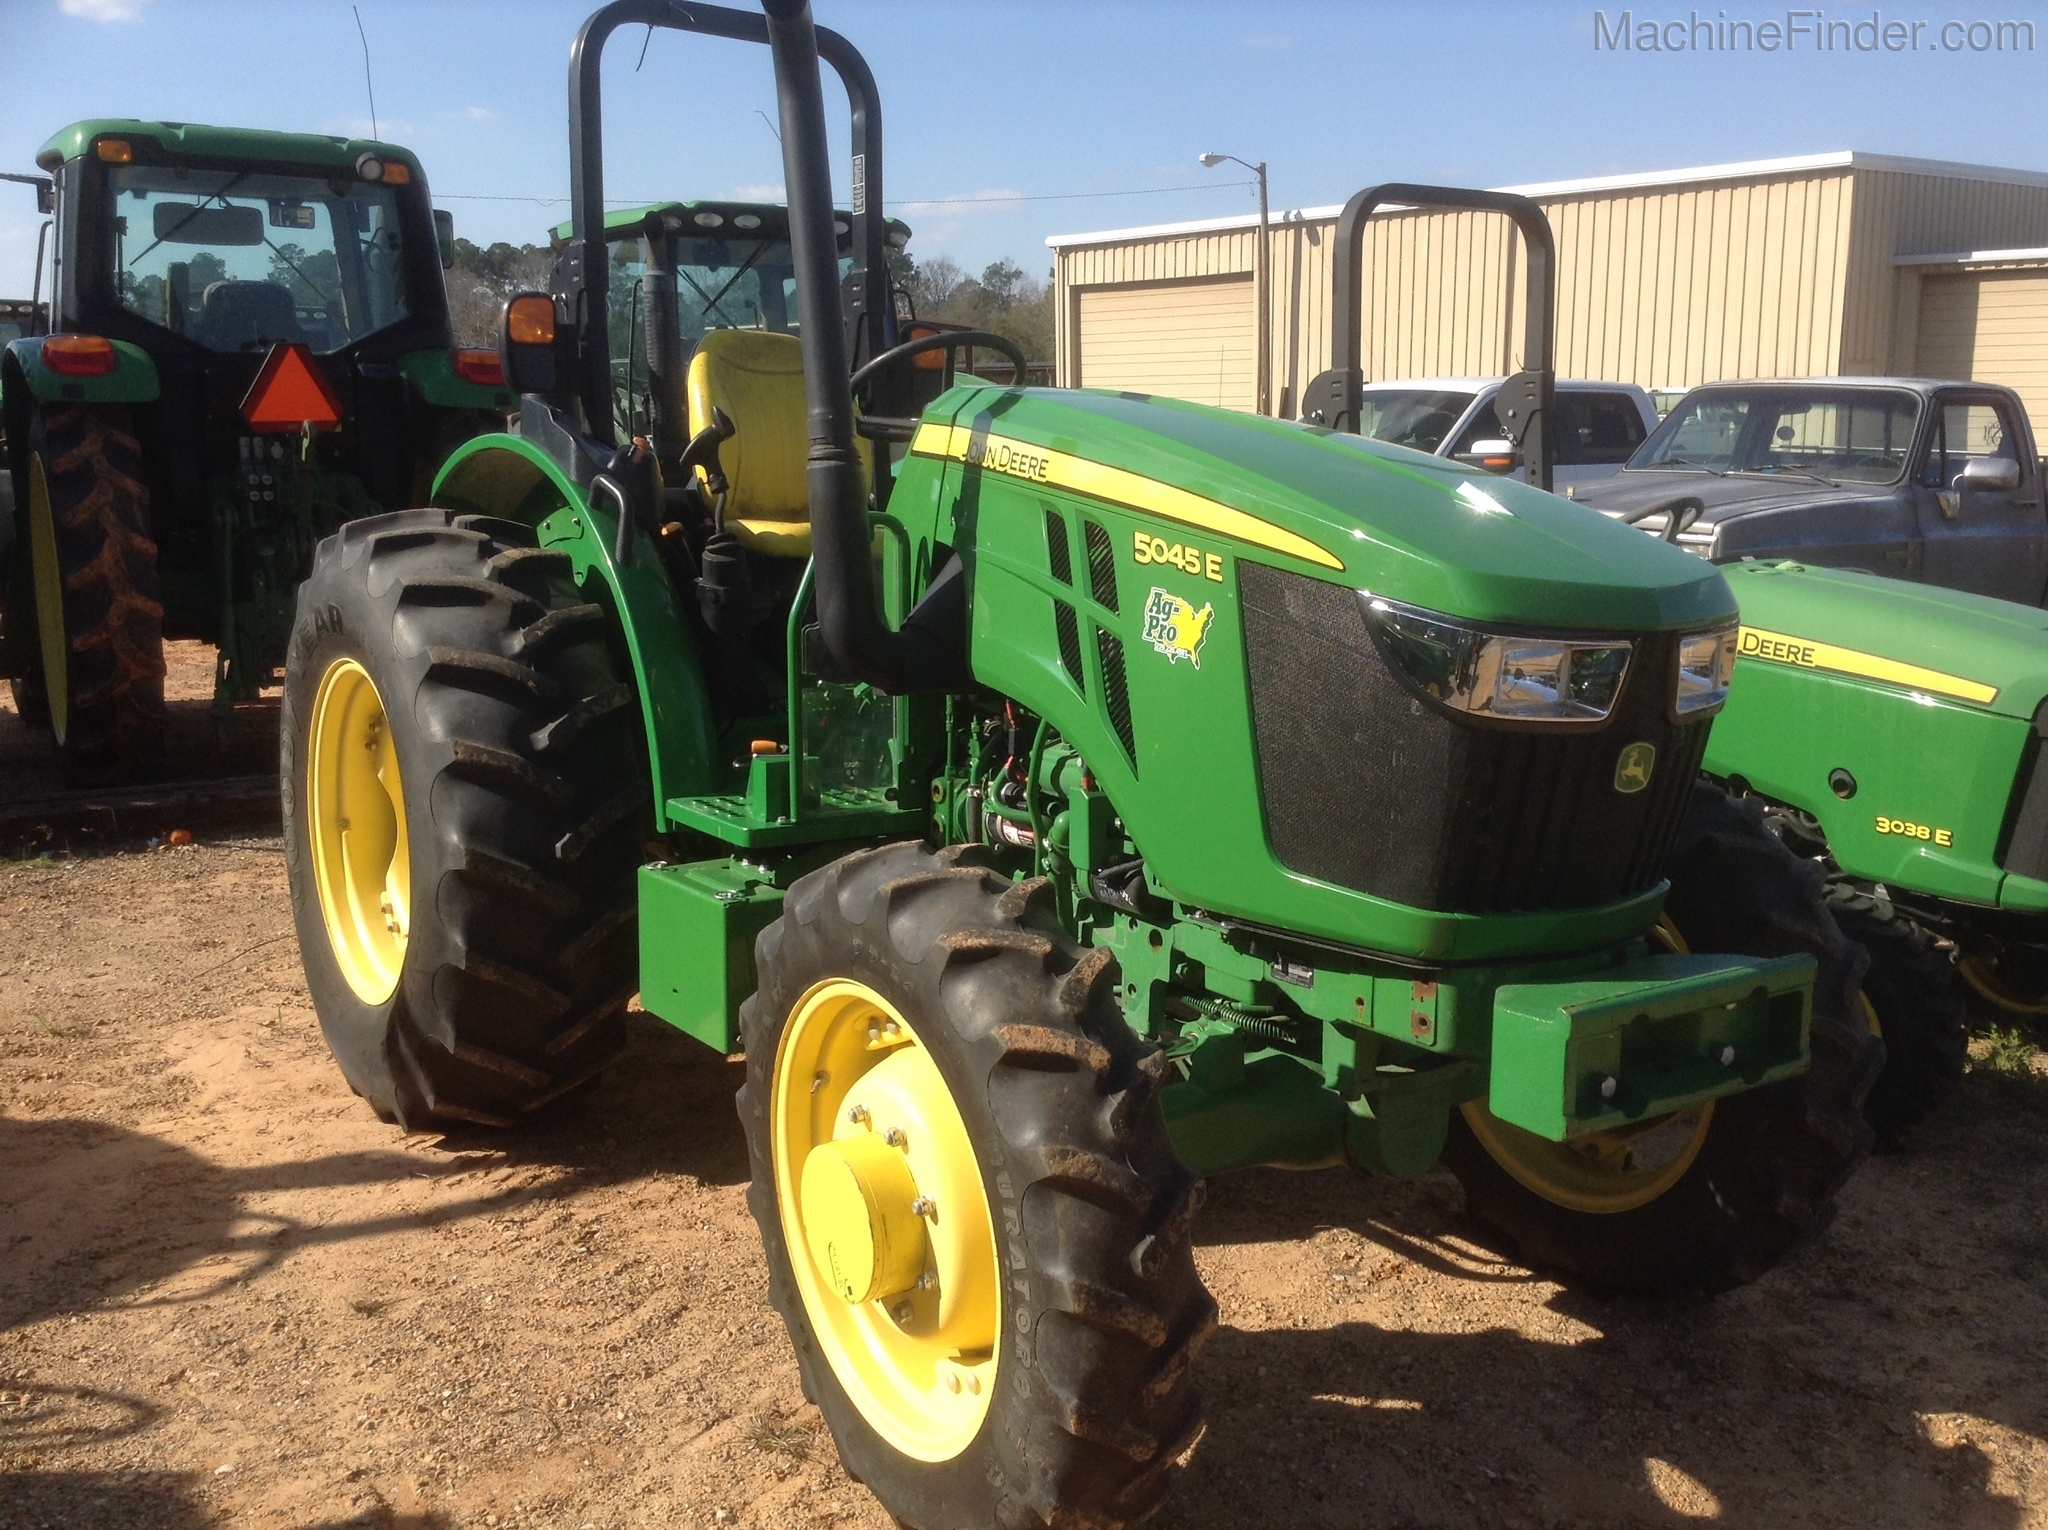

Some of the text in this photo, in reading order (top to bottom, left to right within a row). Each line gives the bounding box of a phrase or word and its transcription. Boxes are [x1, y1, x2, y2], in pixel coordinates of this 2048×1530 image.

[999, 445, 1049, 479] DEERE
[1133, 531, 1223, 583] 5045 E
[1146, 614, 1177, 642] Pro
[1742, 633, 1815, 665] DEERE
[1876, 816, 1953, 847] 3038 E
